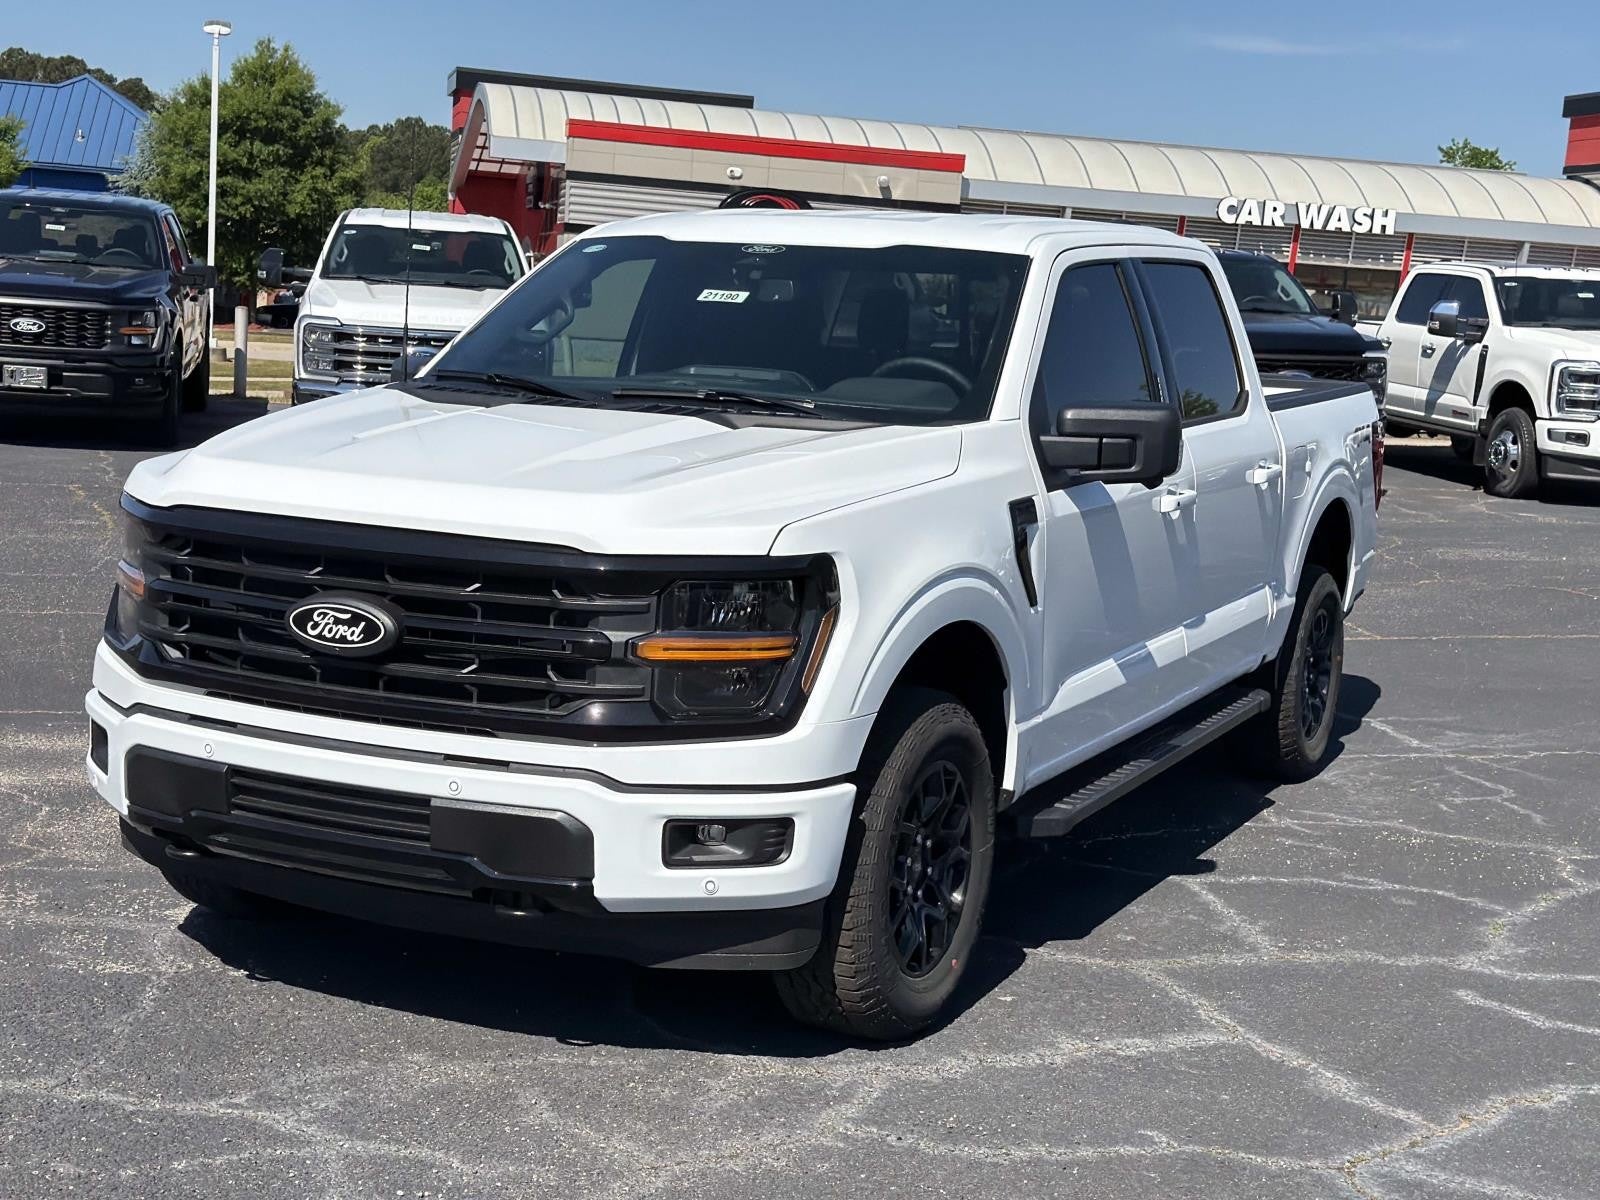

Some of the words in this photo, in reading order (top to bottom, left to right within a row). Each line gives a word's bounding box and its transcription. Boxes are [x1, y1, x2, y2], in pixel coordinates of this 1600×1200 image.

[1217, 196, 1285, 227] CAR
[1297, 202, 1397, 236] WASH
[703, 291, 740, 301] 21190
[306, 608, 366, 642] Ford
